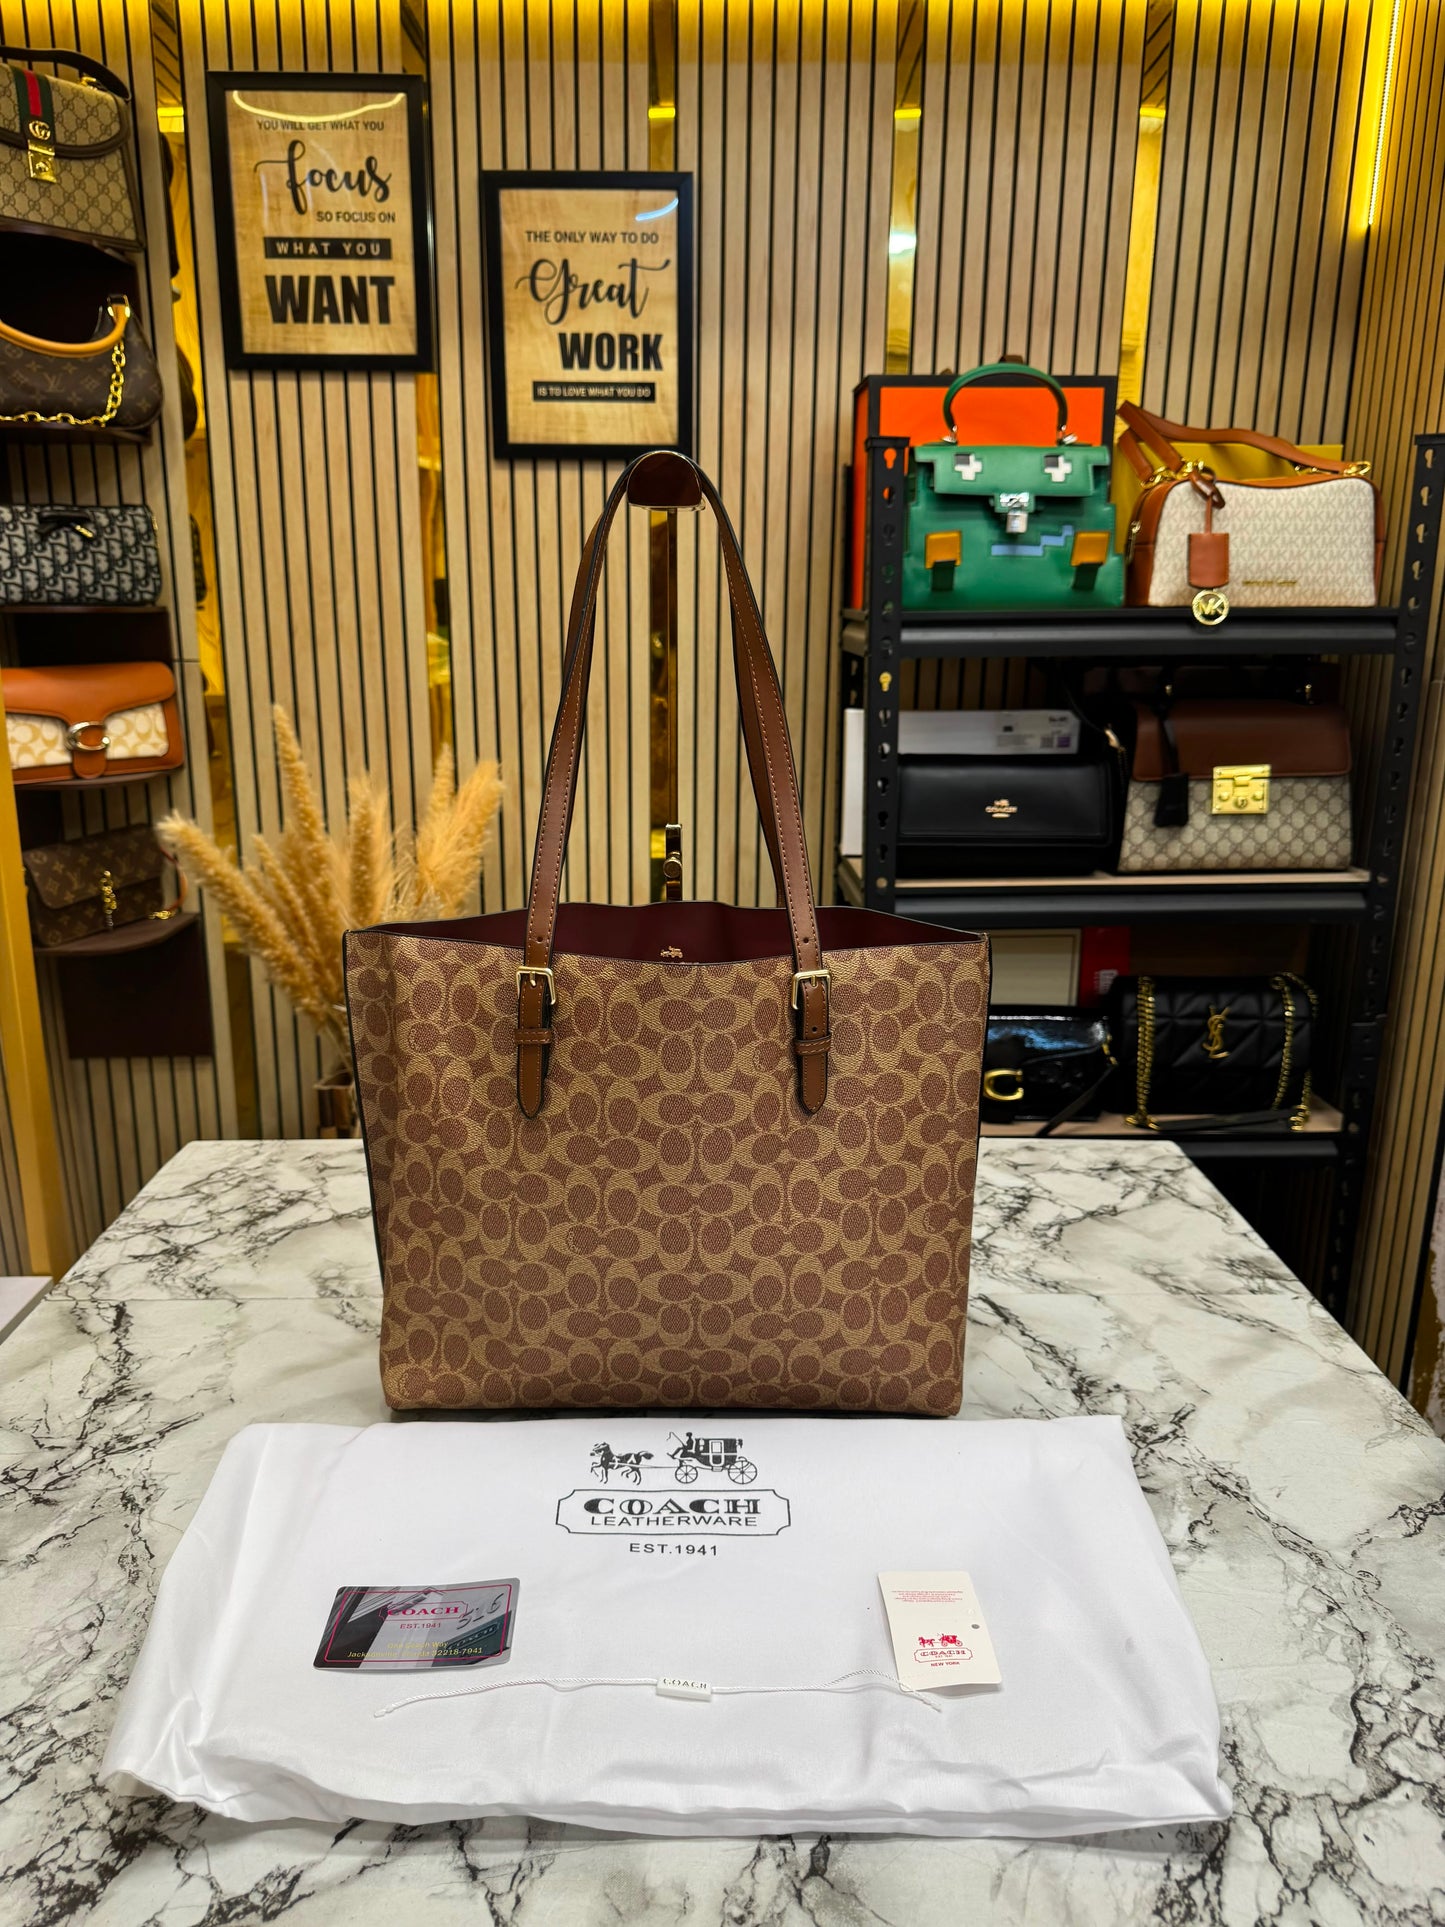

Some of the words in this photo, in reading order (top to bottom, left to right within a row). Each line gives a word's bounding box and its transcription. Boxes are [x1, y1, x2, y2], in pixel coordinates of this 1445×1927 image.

[257, 120, 278, 131] YOU
[281, 120, 305, 131] WILL
[307, 121, 329, 131] GET
[331, 121, 360, 131] WHAT
[363, 121, 385, 131] YOU
[254, 139, 392, 215] focus
[316, 211, 333, 223] SO
[336, 212, 376, 223] FOCUS
[378, 212, 396, 223] ON
[525, 230, 550, 243] THE
[554, 231, 587, 243] ONLY
[589, 231, 617, 244] WAY
[621, 231, 638, 244] TO
[641, 232, 659, 244] DO
[276, 242, 330, 255] WHAT
[342, 242, 381, 256] YOU
[514, 257, 671, 326] Great
[264, 275, 396, 325] WANT
[558, 332, 664, 372] WORK
[537, 387, 548, 397] IS
[549, 387, 562, 397] TO
[563, 387, 587, 397] LOVE
[588, 388, 616, 398] WHAT
[617, 388, 637, 398] YOU
[638, 388, 651, 398] DO
[583, 1497, 762, 1516] COACH
[591, 1515, 758, 1528] LEATHERWARE
[629, 1543, 719, 1557] EST.1941
[387, 1605, 460, 1617] COACH
[663, 1678, 707, 1689] COACH
